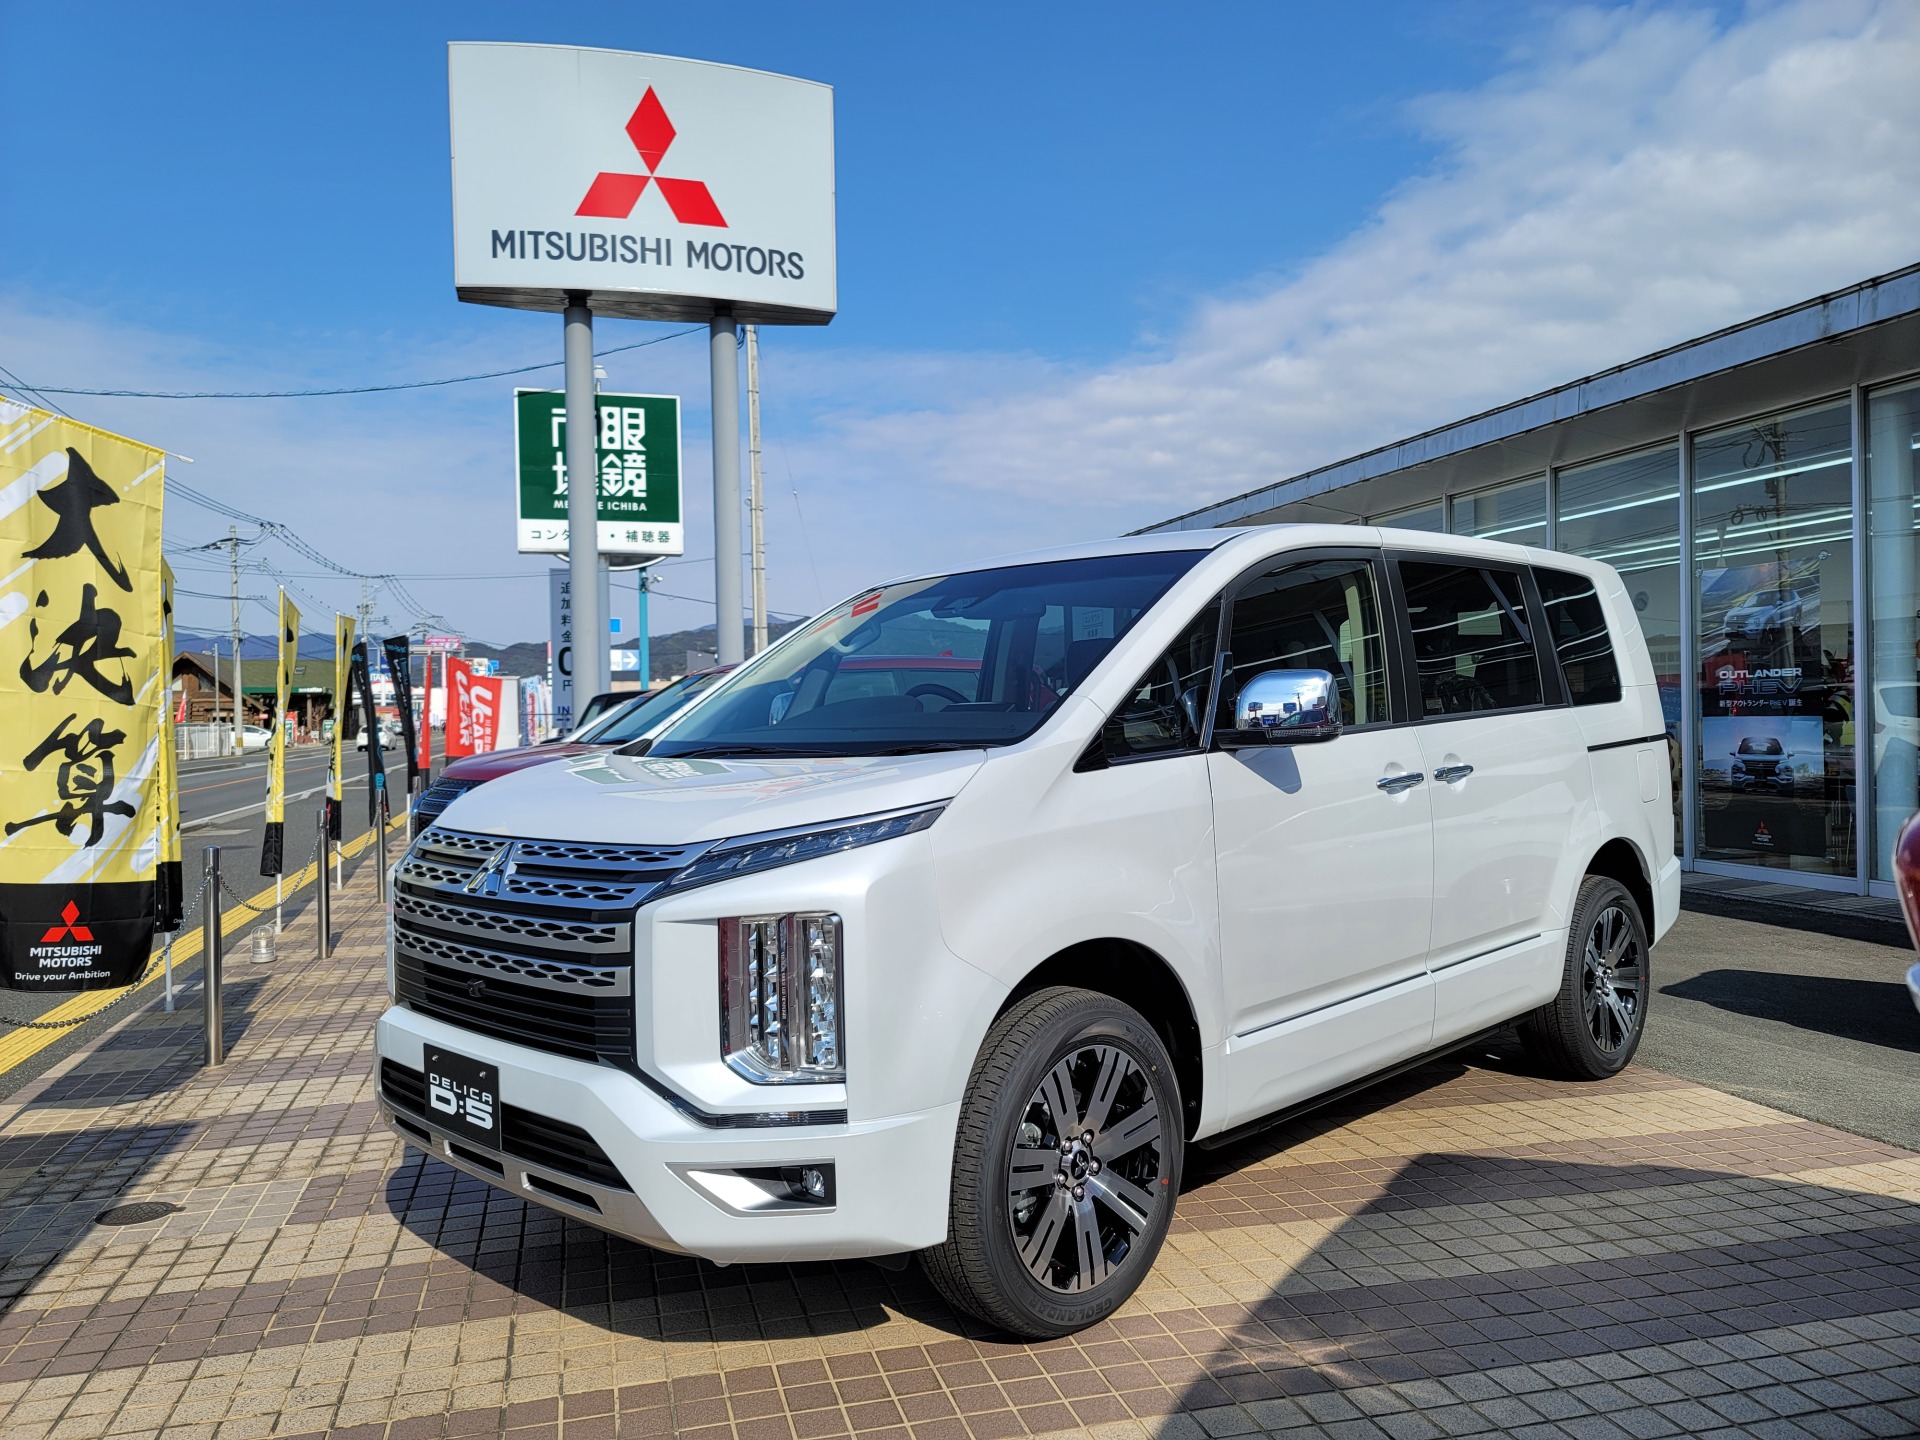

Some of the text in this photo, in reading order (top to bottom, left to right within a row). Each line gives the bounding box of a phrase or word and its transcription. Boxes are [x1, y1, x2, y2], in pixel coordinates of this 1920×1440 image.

[491, 229, 805, 280] MITSUBISHI MOTORS
[600, 406, 647, 498] 眼鏡
[607, 502, 647, 511] ICHIBA
[5, 445, 136, 848] 大決算
[1719, 667, 1802, 679] OUTLANDER
[1719, 678, 1803, 696] PHEV
[29, 945, 102, 957] MITSUBISHI
[39, 956, 92, 968] MOTORS
[15, 970, 110, 982] Drive your Ambition
[429, 1072, 493, 1105] DELICA
